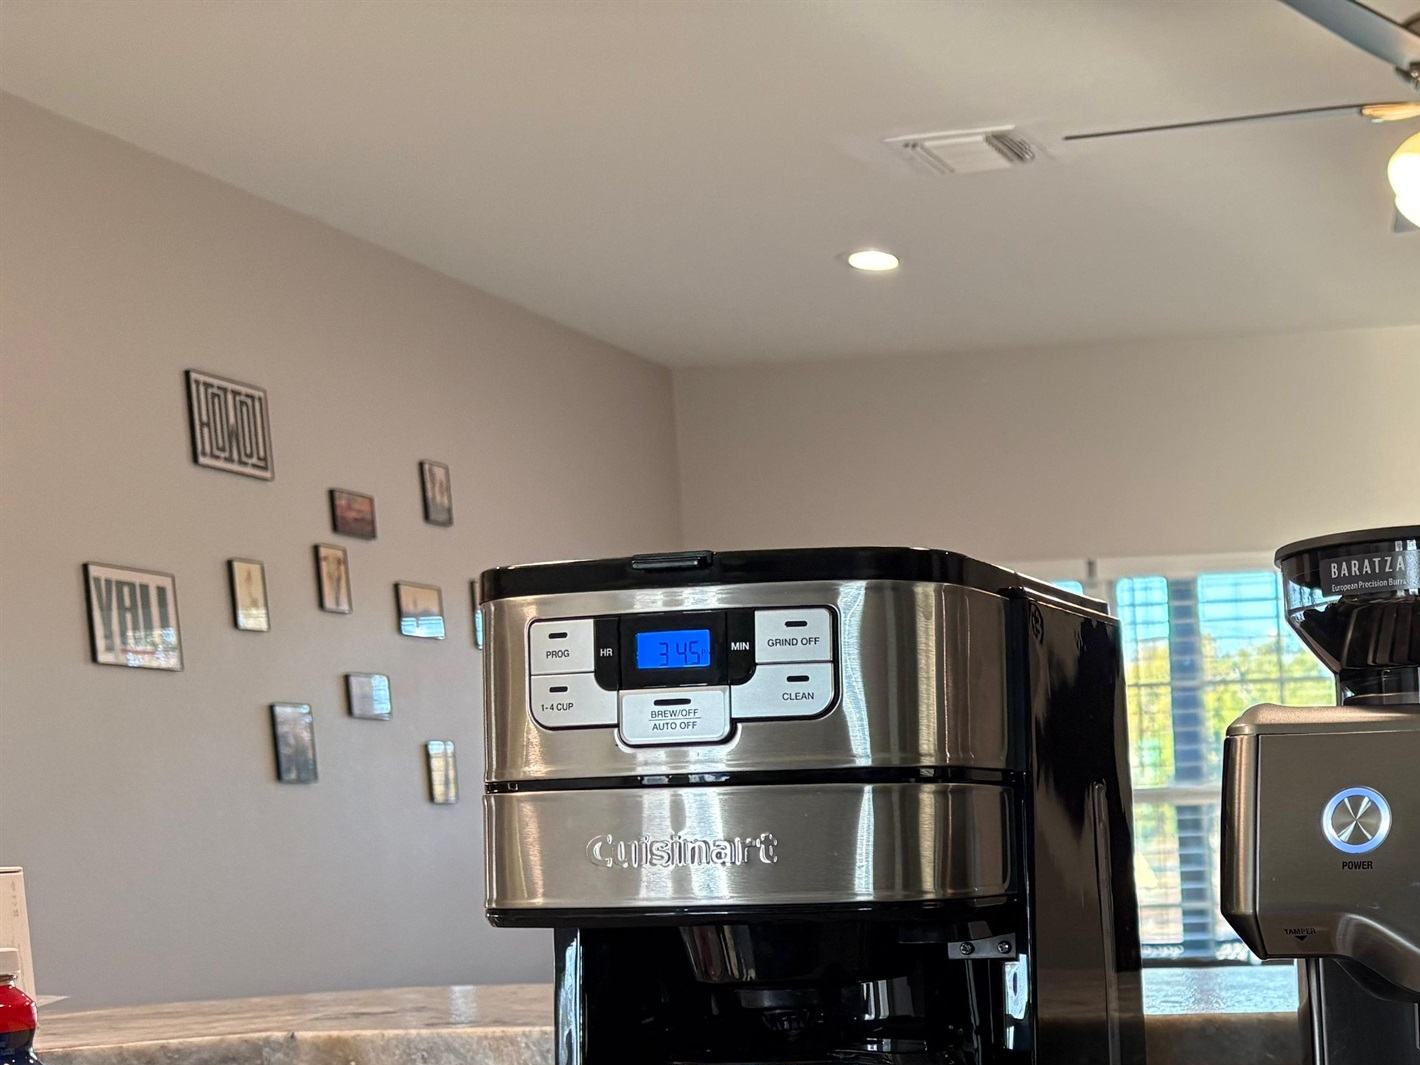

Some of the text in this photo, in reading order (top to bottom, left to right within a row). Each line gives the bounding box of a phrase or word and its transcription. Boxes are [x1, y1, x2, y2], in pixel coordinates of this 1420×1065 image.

[1331, 556, 1405, 578] BARATZA
[1332, 583, 1358, 592] European
[1358, 579, 1388, 589] Precision
[731, 641, 750, 651] MIN
[767, 636, 820, 648] GRIND OFF
[545, 648, 570, 660] PROG
[600, 647, 613, 658] HR
[782, 691, 814, 702] CLEAN
[556, 702, 574, 712] CUP
[650, 708, 699, 719] BREW/OFF
[652, 720, 698, 731] AUTO OFF
[586, 832, 778, 868] Cuisinart
[1342, 860, 1373, 870] POWER
[1284, 927, 1316, 935] TAMPER
